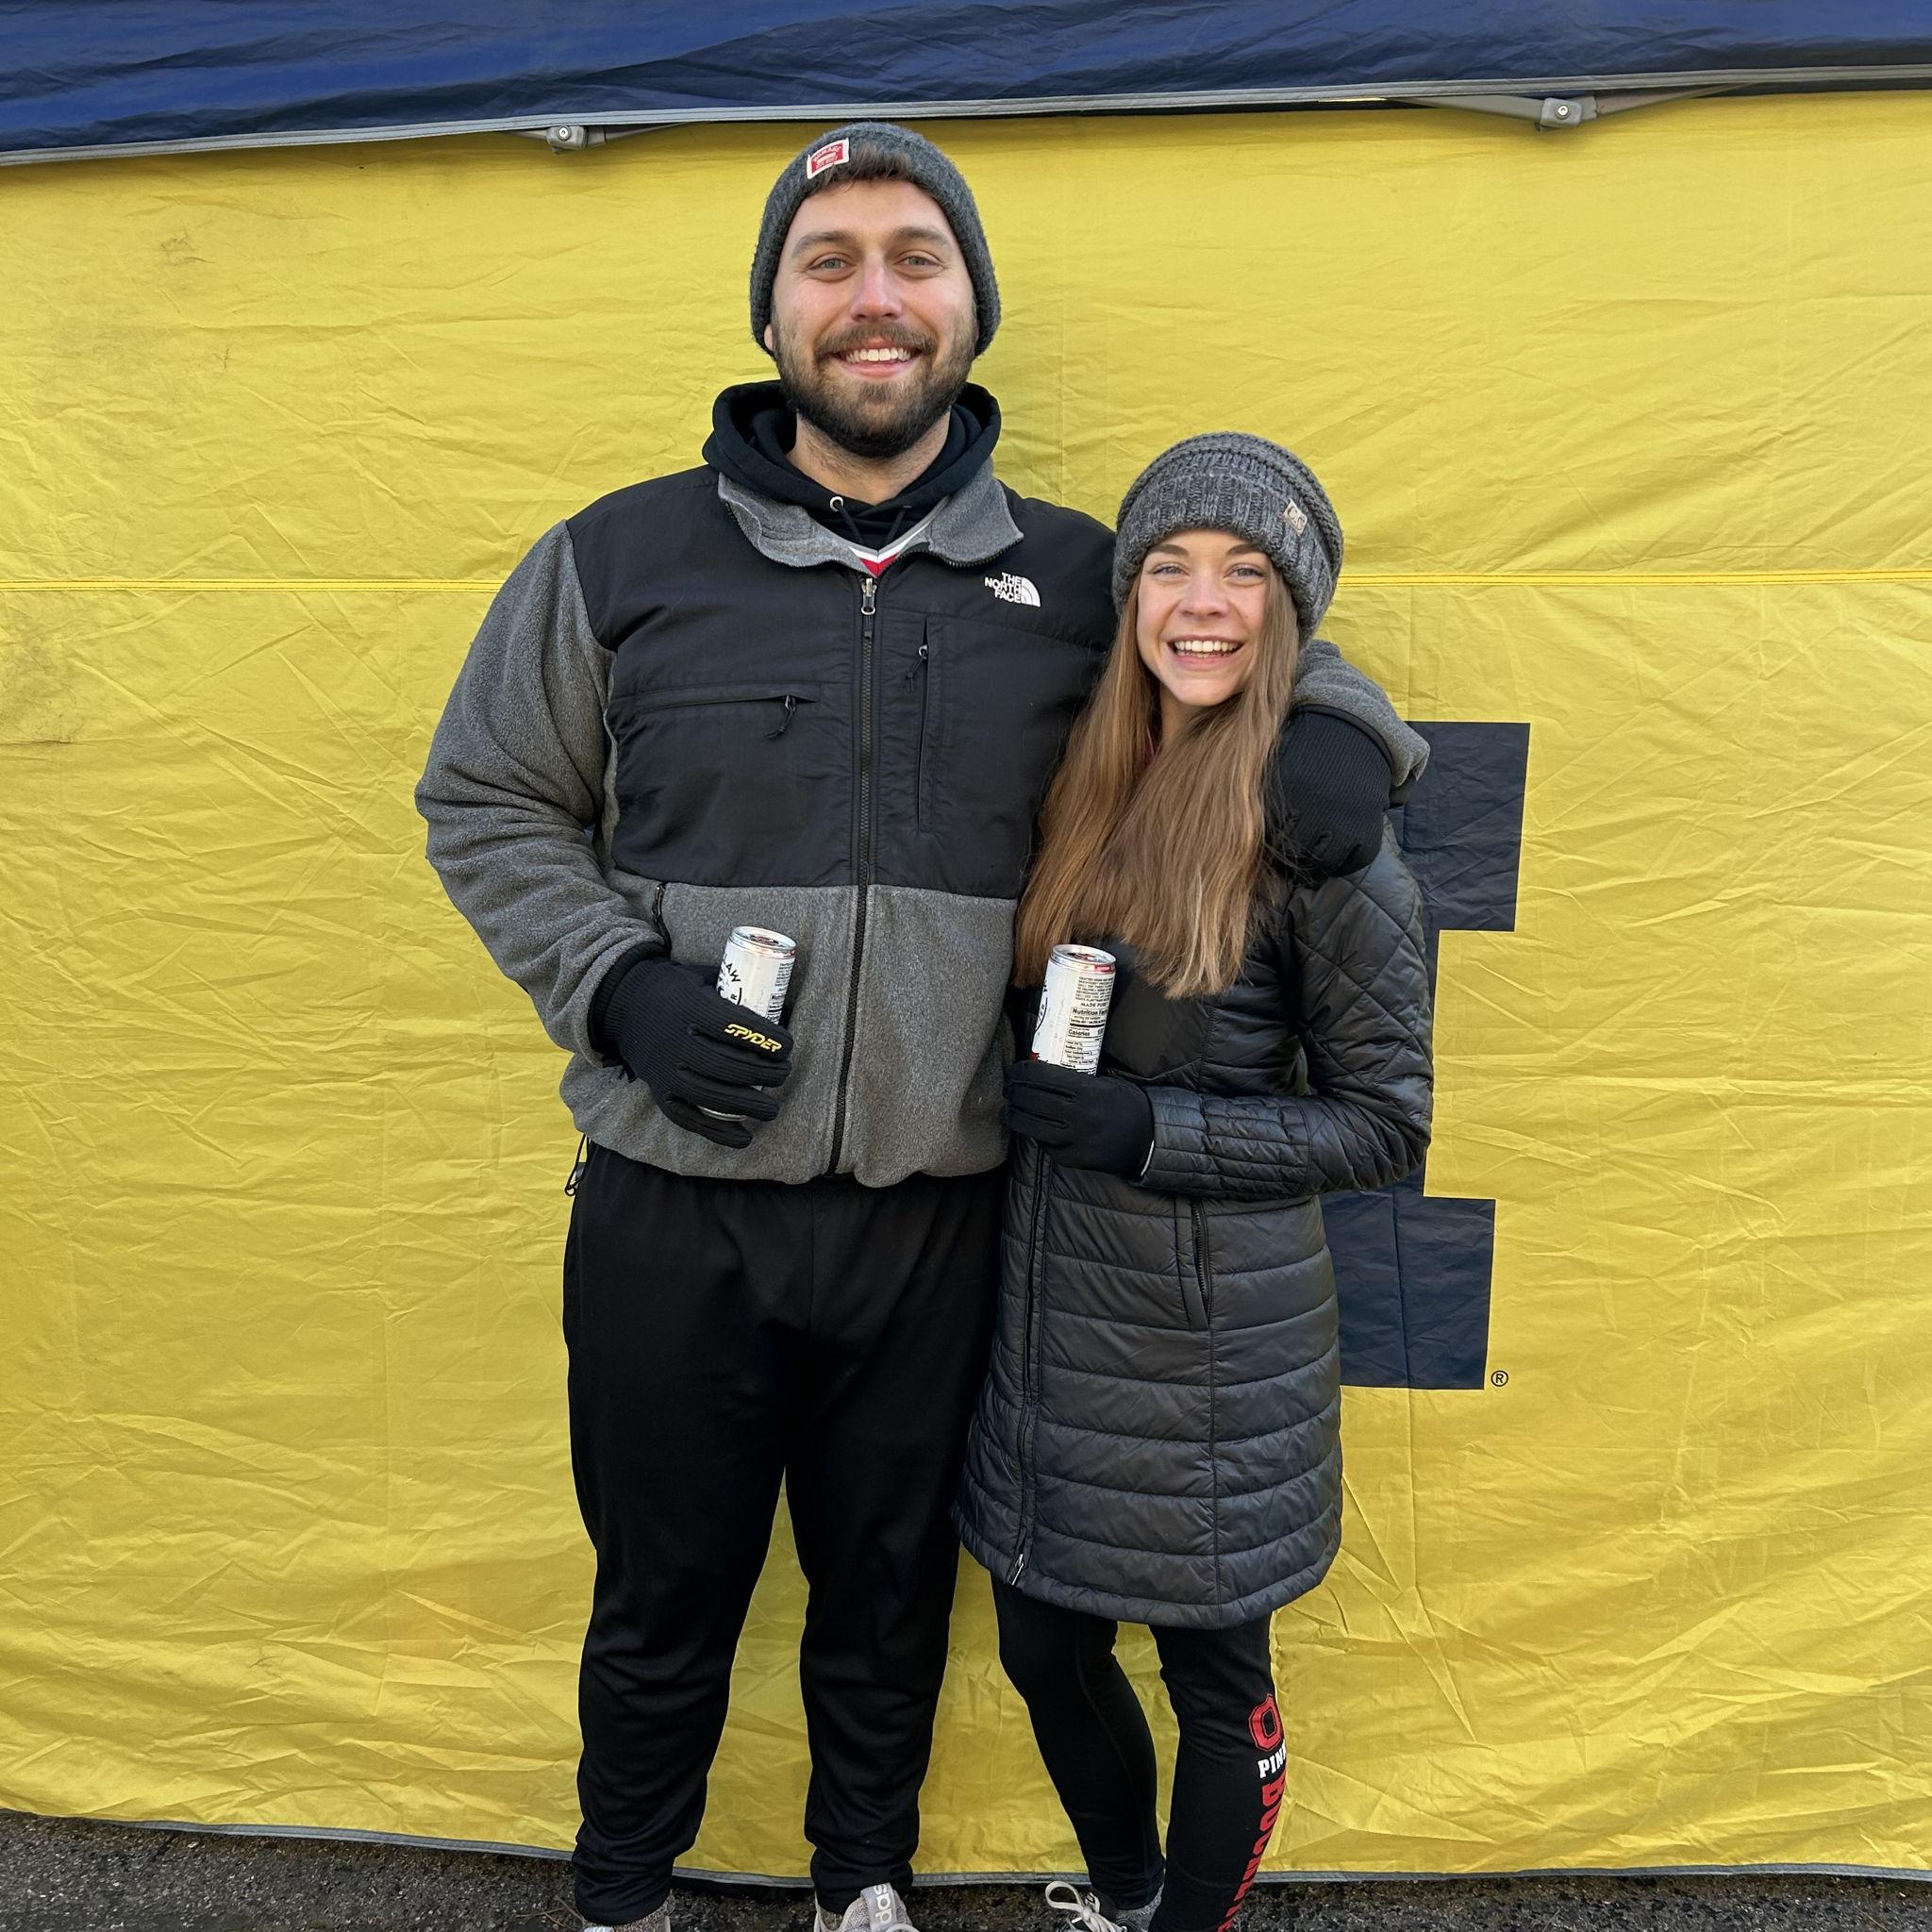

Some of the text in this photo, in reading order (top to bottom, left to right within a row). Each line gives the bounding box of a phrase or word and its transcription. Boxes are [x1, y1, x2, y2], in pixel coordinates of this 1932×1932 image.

[984, 576, 1022, 594] NORTH
[1002, 572, 1022, 585] THE
[994, 589, 1022, 604] FACE
[1072, 1008, 1098, 1016] Nutrition
[724, 1024, 782, 1053] SPYDER
[873, 1884, 892, 1924] das
